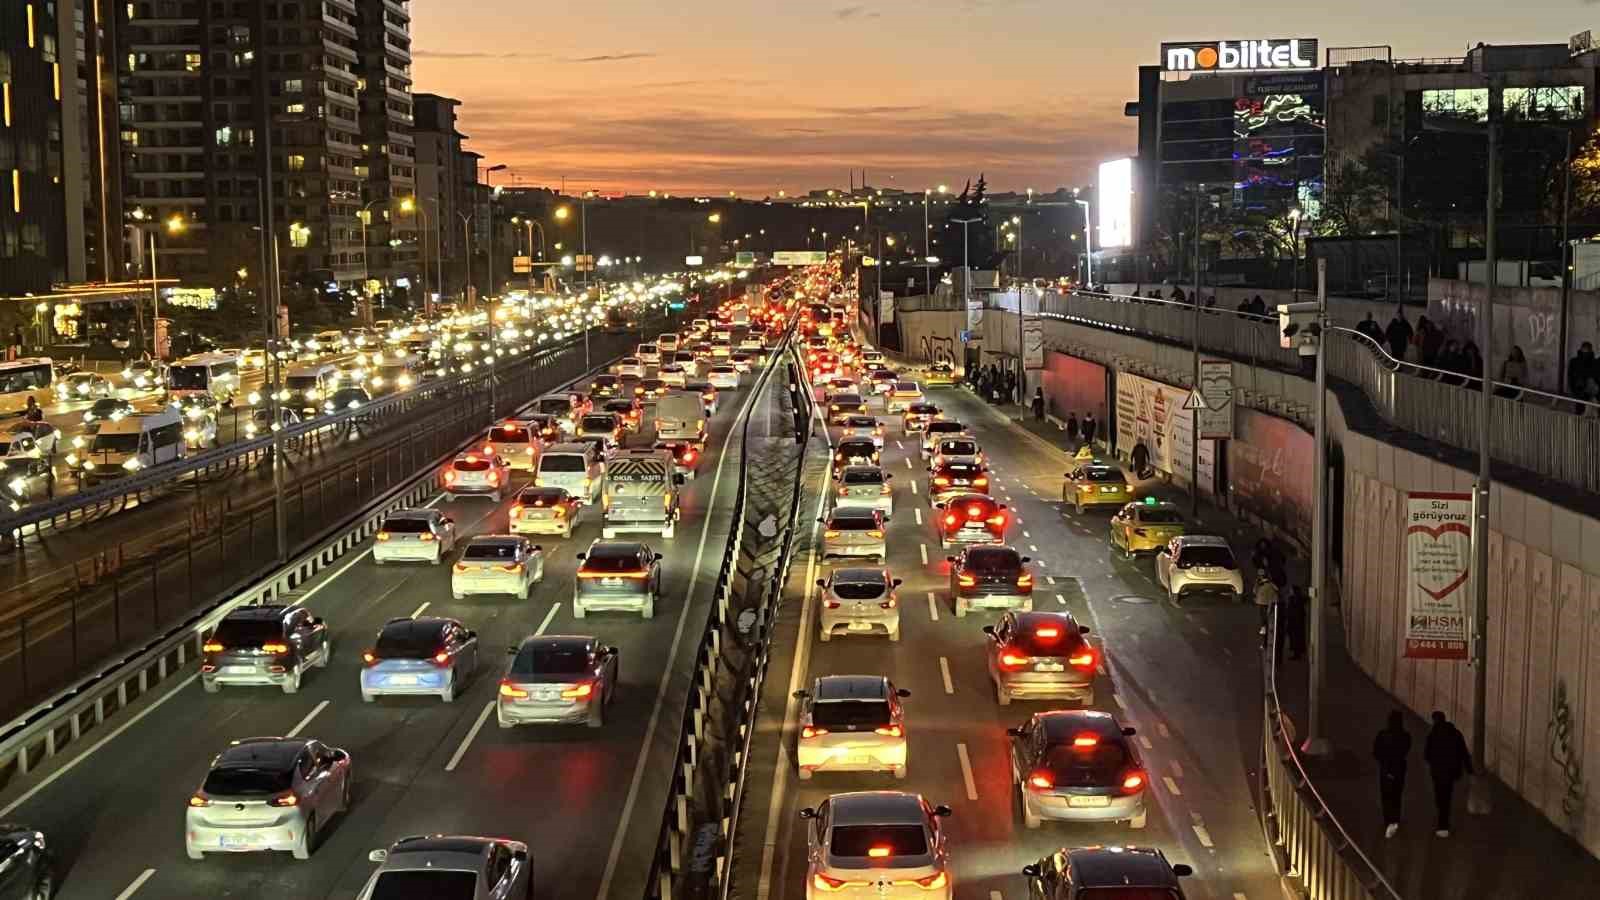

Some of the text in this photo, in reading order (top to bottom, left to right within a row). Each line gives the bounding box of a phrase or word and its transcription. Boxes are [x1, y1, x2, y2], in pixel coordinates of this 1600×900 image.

[1167, 39, 1311, 70] mobiltel
[1431, 501, 1449, 509] Sizi
[1412, 511, 1467, 522] görüyoruz
[1428, 616, 1464, 627] HSM
